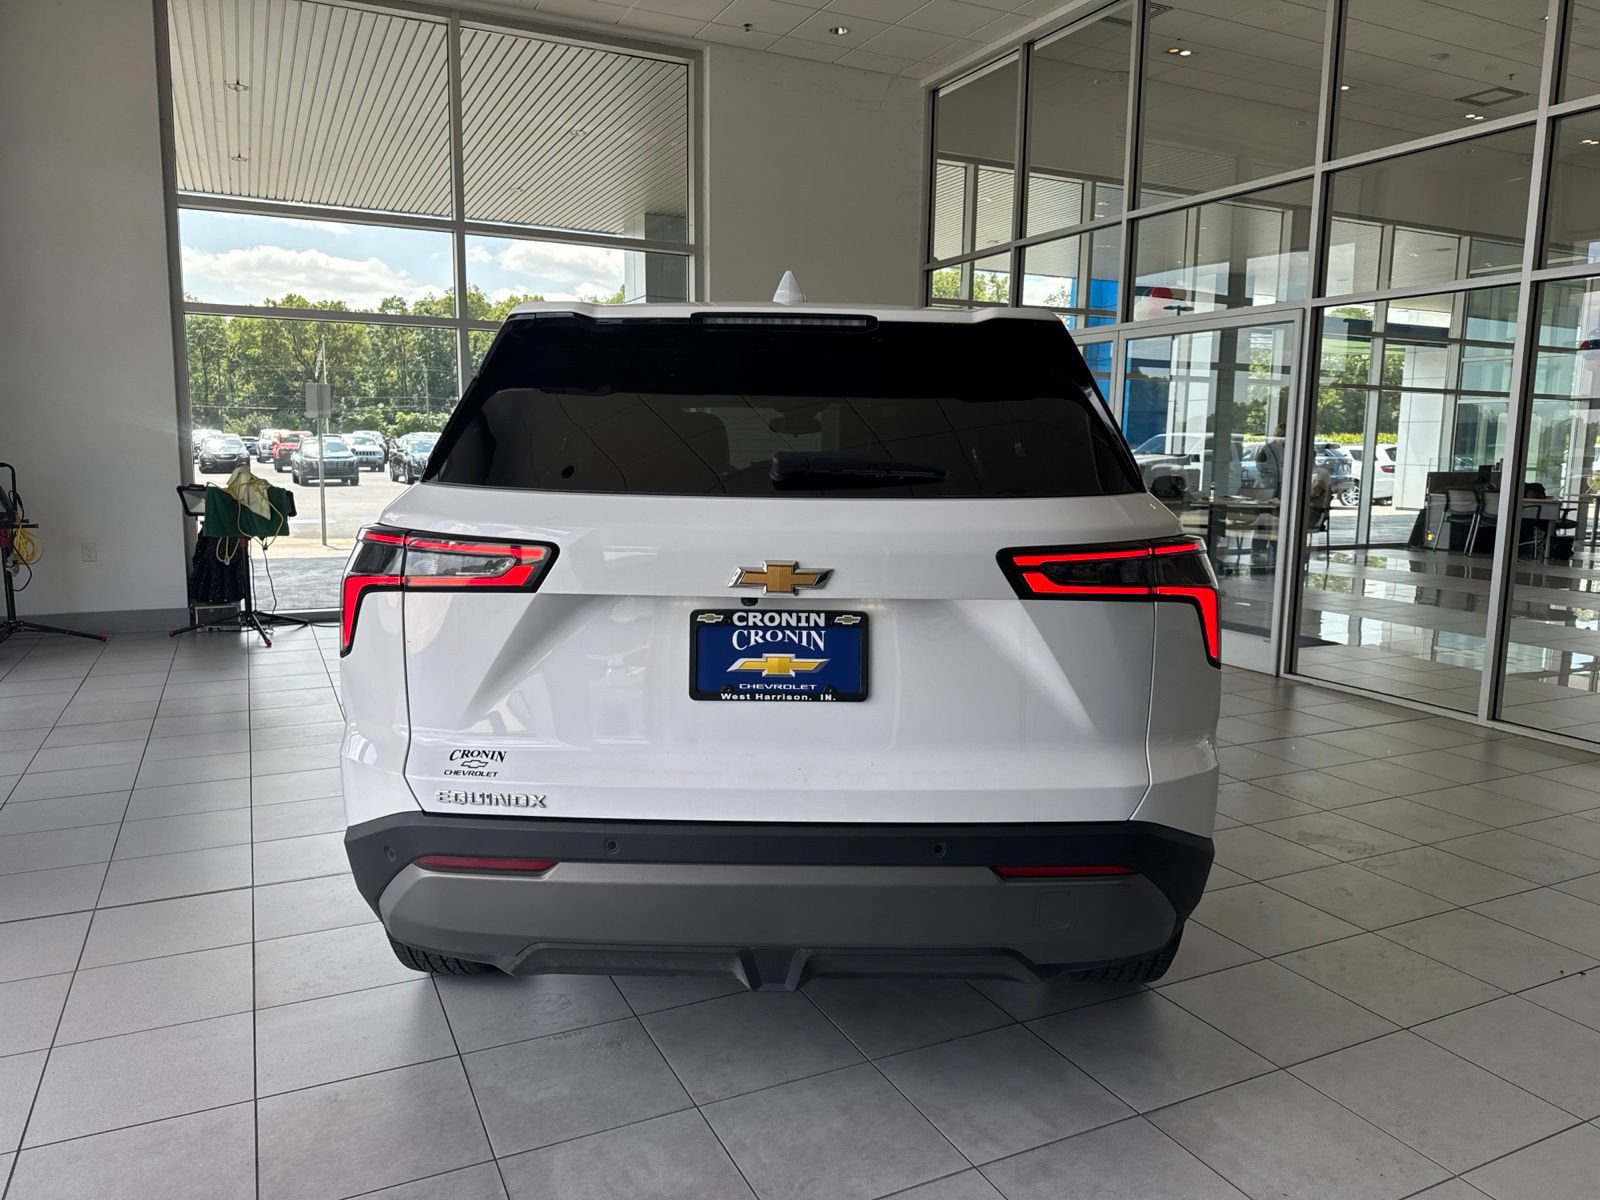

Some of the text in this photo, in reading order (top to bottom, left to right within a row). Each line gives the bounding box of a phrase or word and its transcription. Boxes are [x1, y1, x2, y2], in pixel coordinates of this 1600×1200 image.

[733, 612, 825, 627] CRONIN
[732, 629, 826, 651] CRONIN
[449, 749, 507, 762] CRONIN
[443, 769, 499, 778] CHEVROLET
[436, 789, 547, 808] EQUINOX
